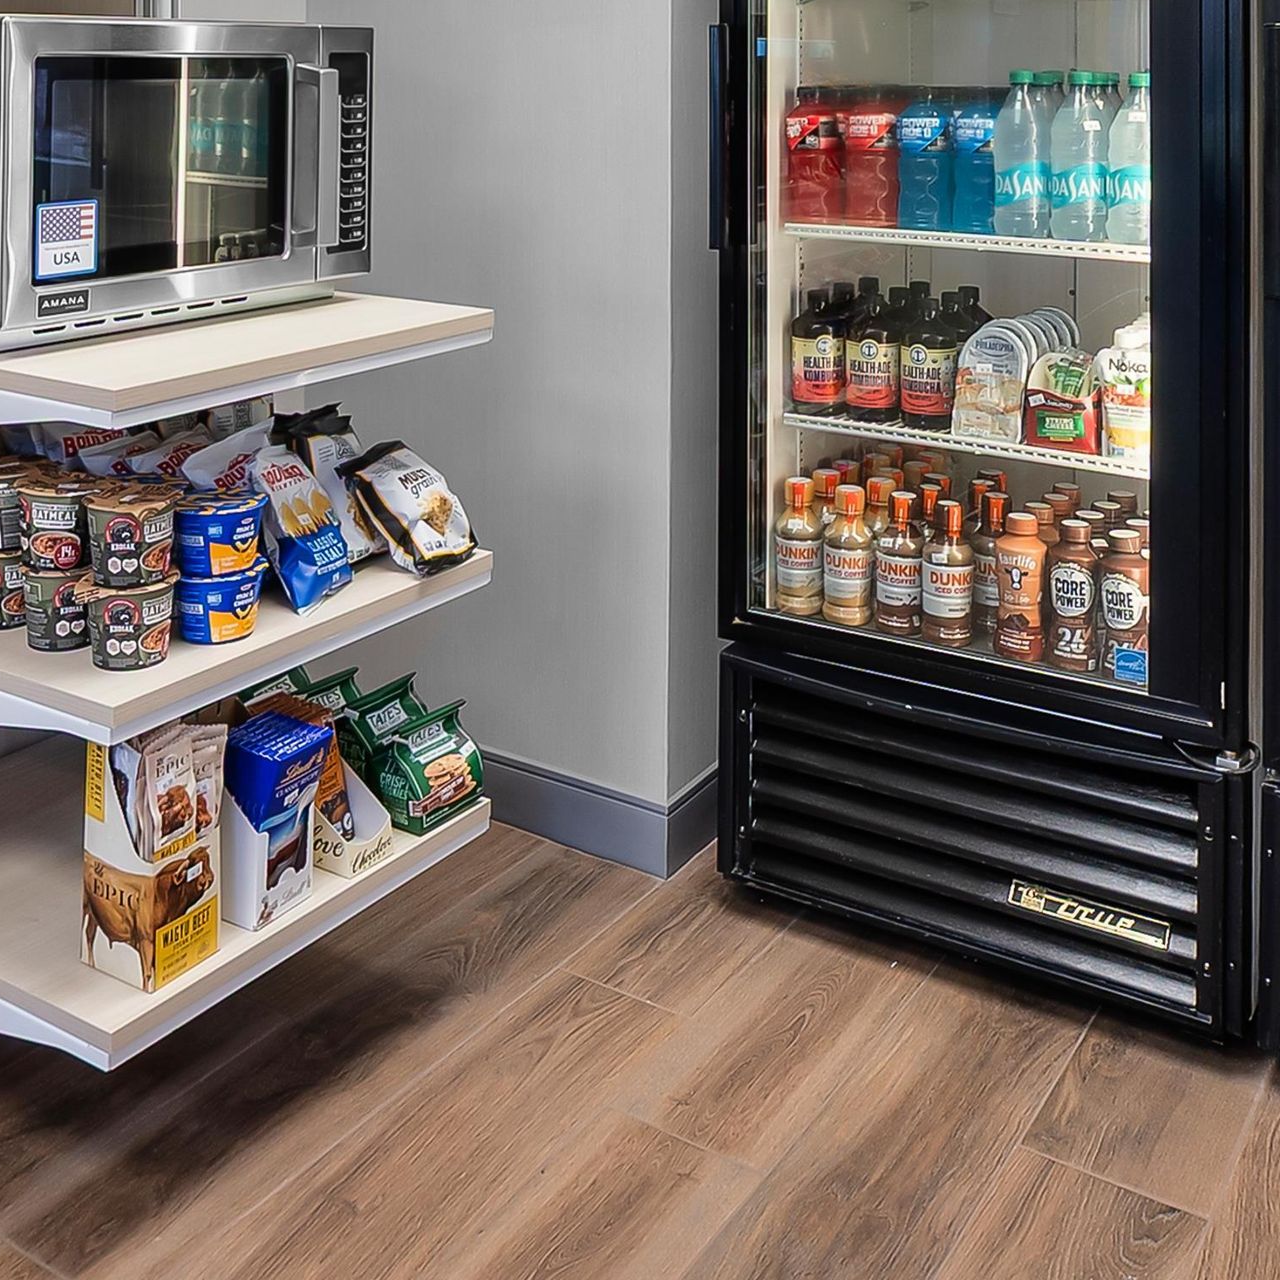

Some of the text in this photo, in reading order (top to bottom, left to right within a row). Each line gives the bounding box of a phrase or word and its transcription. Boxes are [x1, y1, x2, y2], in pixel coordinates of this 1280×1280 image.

[849, 115, 886, 125] POWER
[901, 118, 940, 128] POWER
[957, 119, 994, 128] POWER
[53, 251, 81, 266] USA
[41, 295, 85, 310] AMANA
[974, 337, 1015, 354] PHILADELPHIA
[850, 373, 892, 387] KOMBUCHA
[398, 468, 431, 491] MULTI
[31, 508, 78, 521] OATMEAL
[110, 543, 136, 552] KODIAK
[307, 531, 339, 552] CLASSIC
[790, 560, 814, 568] COFFEE
[998, 552, 1037, 569] fairlife
[889, 576, 917, 585] COFFEE
[1055, 578, 1086, 596] CORE
[934, 586, 952, 594] ICED
[1055, 597, 1086, 609] POWER
[1106, 590, 1134, 609] CORE
[1107, 608, 1134, 621] POWER
[109, 625, 134, 634] KODIAK
[155, 753, 190, 779] EPIC
[92, 878, 140, 909] EPIC
[1057, 901, 1135, 929] true
[161, 905, 212, 950] WAGYU BEEF
